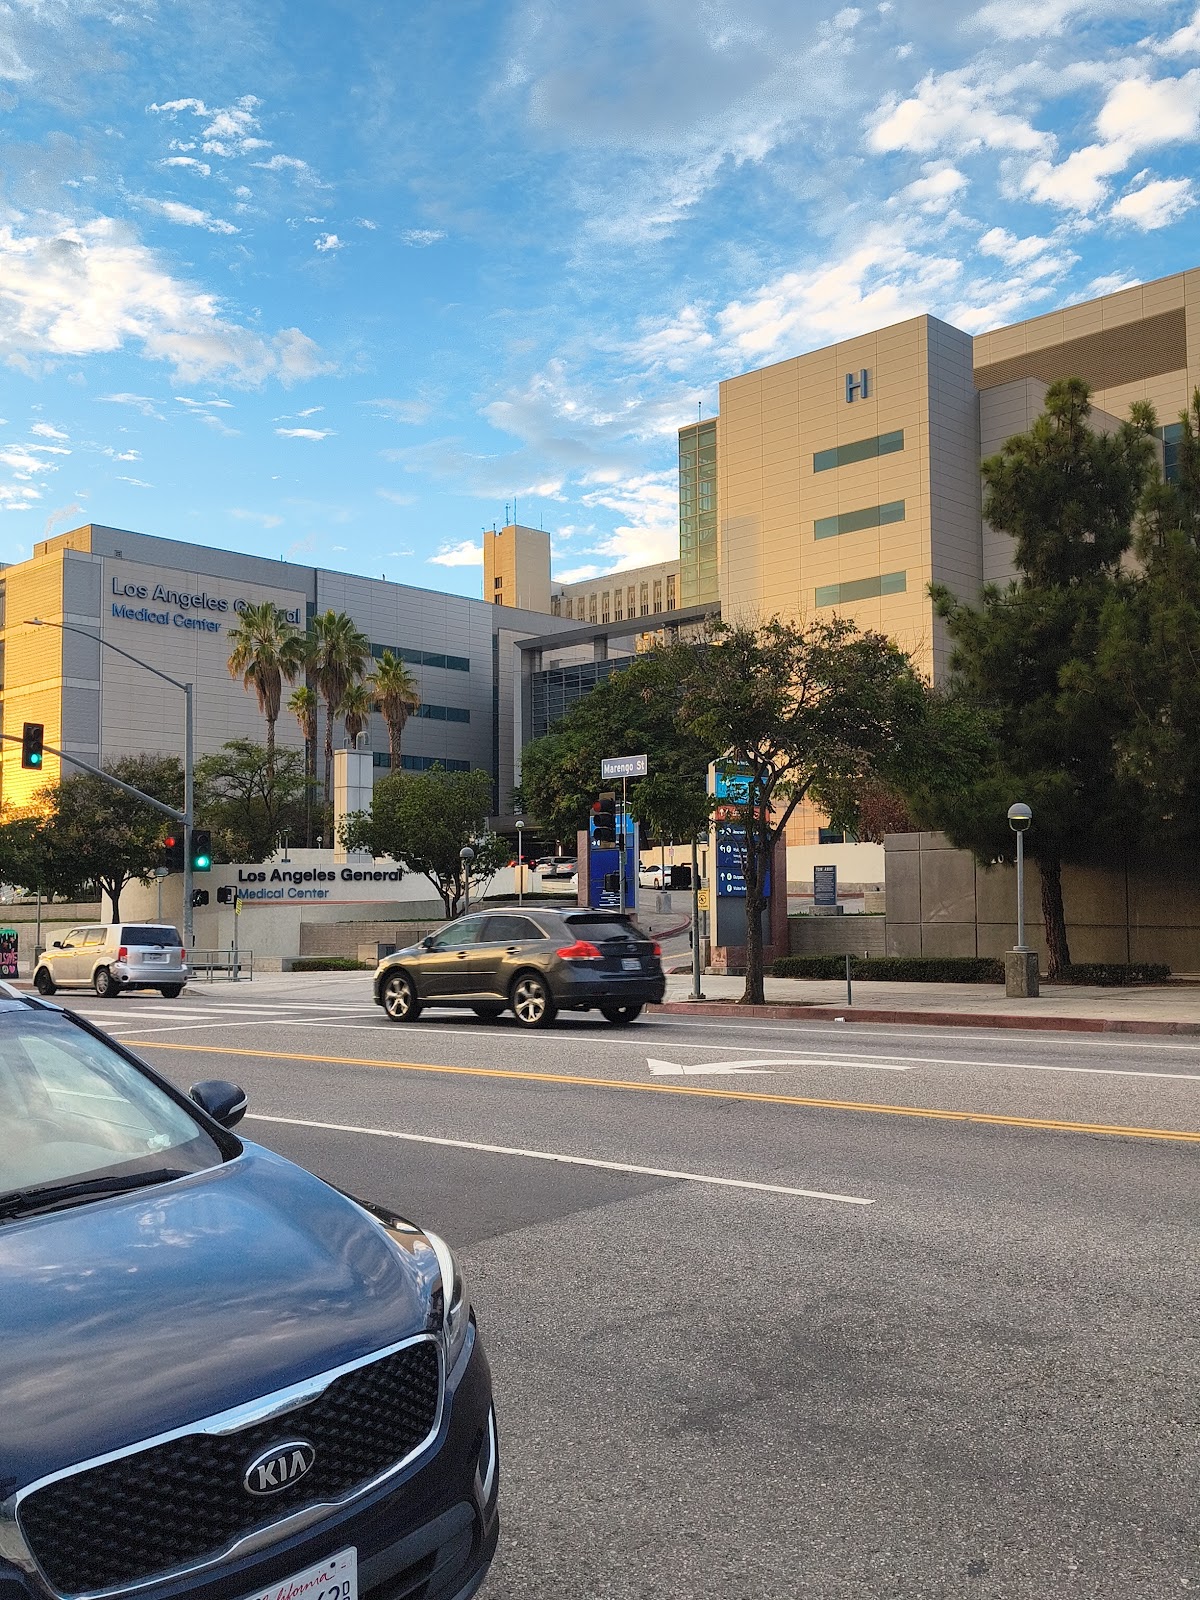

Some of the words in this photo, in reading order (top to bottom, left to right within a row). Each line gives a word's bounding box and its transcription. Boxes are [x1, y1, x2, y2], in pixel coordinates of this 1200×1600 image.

[845, 368, 867, 403] H
[112, 577, 148, 598] Los
[152, 584, 228, 612] Angeles
[112, 603, 169, 625] Medical
[173, 614, 221, 632] Center
[604, 763, 633, 774] Marengo
[636, 760, 644, 770] St
[238, 869, 266, 882] Los
[270, 868, 336, 884] Angeles
[340, 868, 403, 882] General
[238, 887, 284, 899] Medical
[287, 887, 329, 898] Center
[257, 1450, 306, 1489] KIA
[262, 1571, 335, 1600] lifornia
